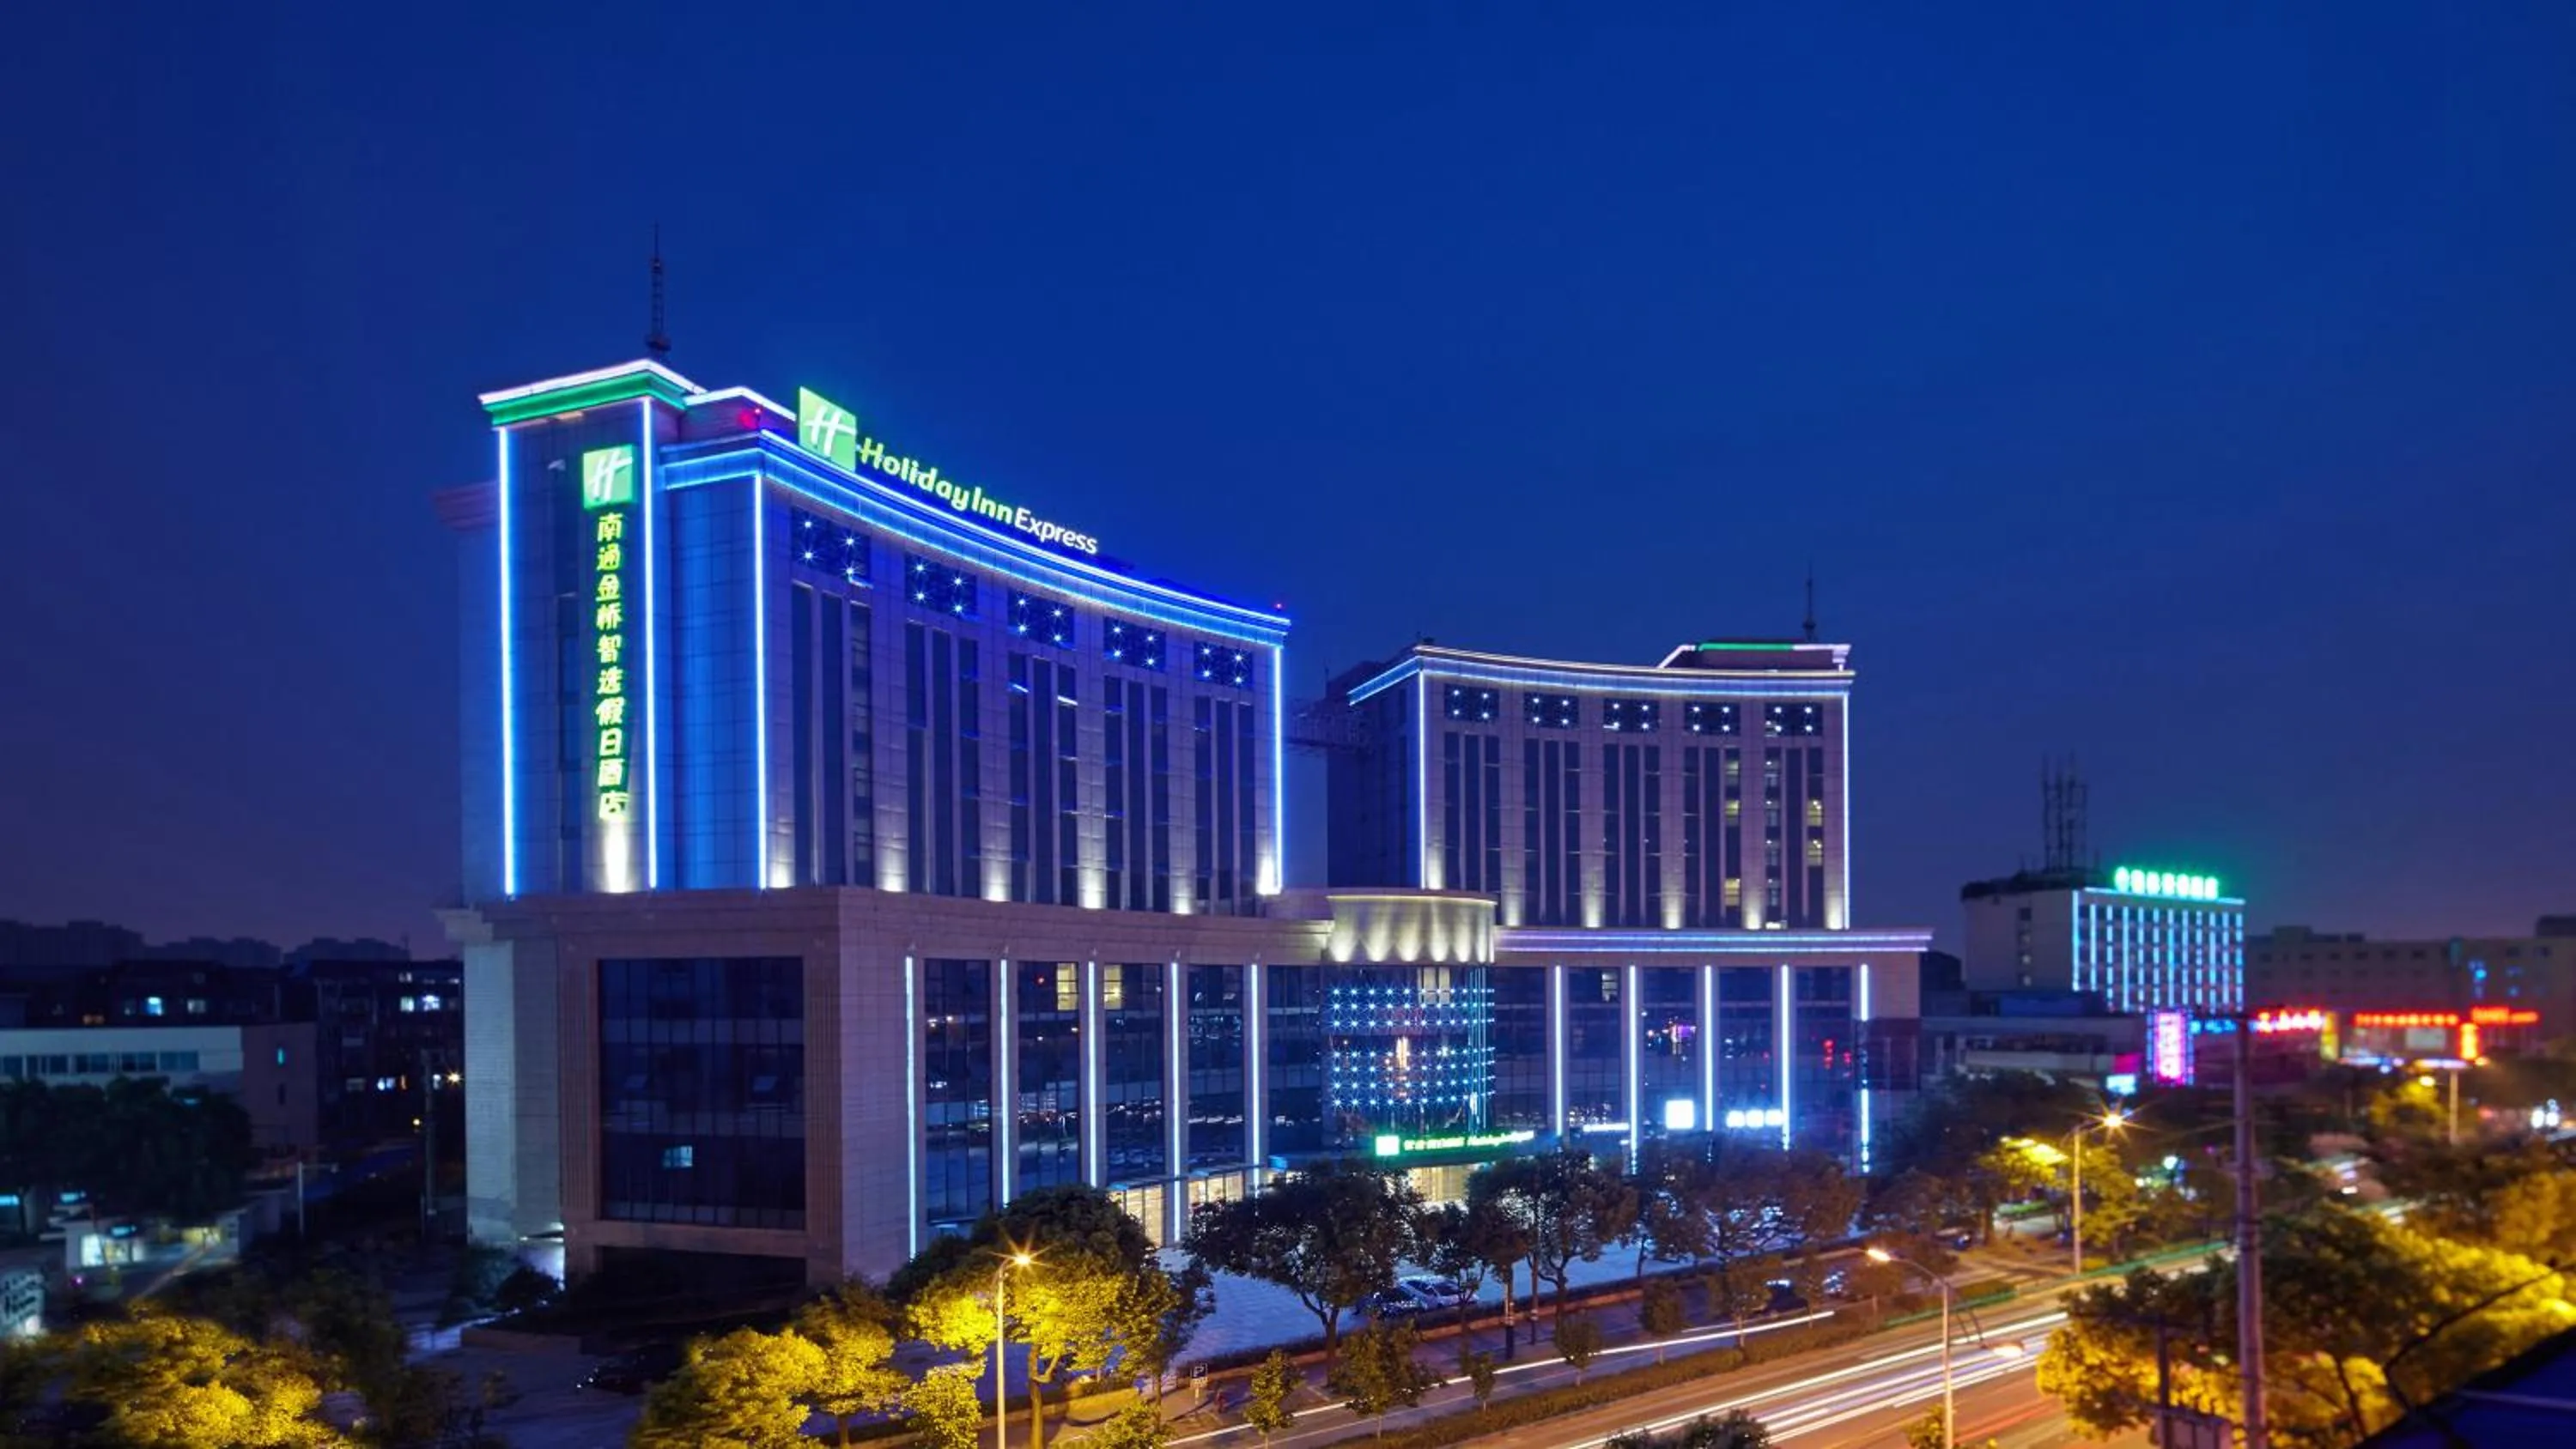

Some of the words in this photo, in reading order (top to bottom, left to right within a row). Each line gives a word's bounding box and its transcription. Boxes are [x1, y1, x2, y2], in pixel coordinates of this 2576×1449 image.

[856, 437, 970, 512] Holiday
[971, 487, 1012, 524] Inn
[1014, 507, 1098, 555] Express
[595, 512, 629, 821] 南通金桥智选假日酒店
